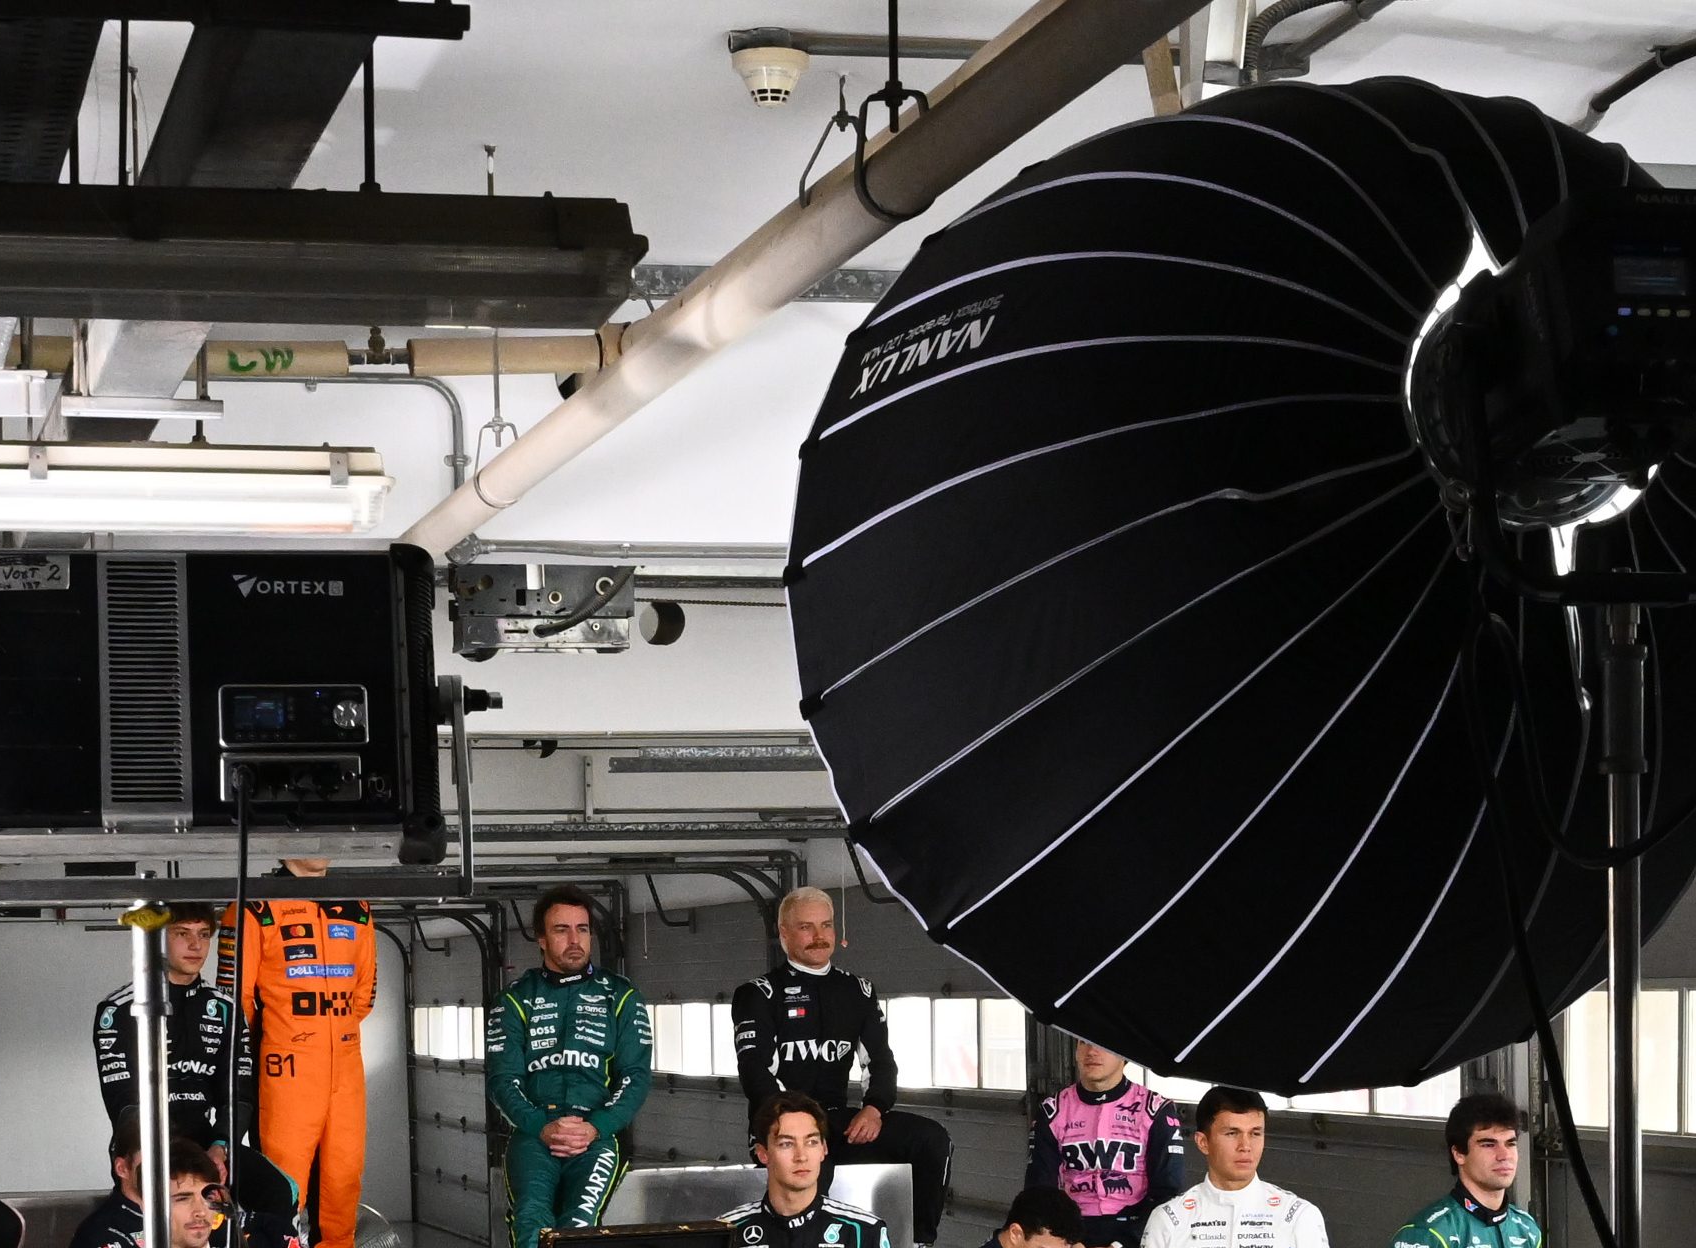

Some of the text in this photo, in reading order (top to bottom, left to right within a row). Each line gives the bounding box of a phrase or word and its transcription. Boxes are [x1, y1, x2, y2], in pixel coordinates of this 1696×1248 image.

[850, 315, 996, 399] NANLUX
[47, 564, 61, 581] 2
[232, 574, 326, 598] VORTEX
[288, 966, 313, 976] DELL
[530, 1026, 556, 1036] BOSS
[528, 1050, 600, 1073] aramco
[780, 1038, 836, 1062] TWG
[266, 1054, 295, 1078] 81
[1061, 1138, 1143, 1172] BWT
[578, 1148, 616, 1215] MARTIN
[1190, 1220, 1226, 1228] KOMATSU
[1199, 1233, 1226, 1241] Claude
